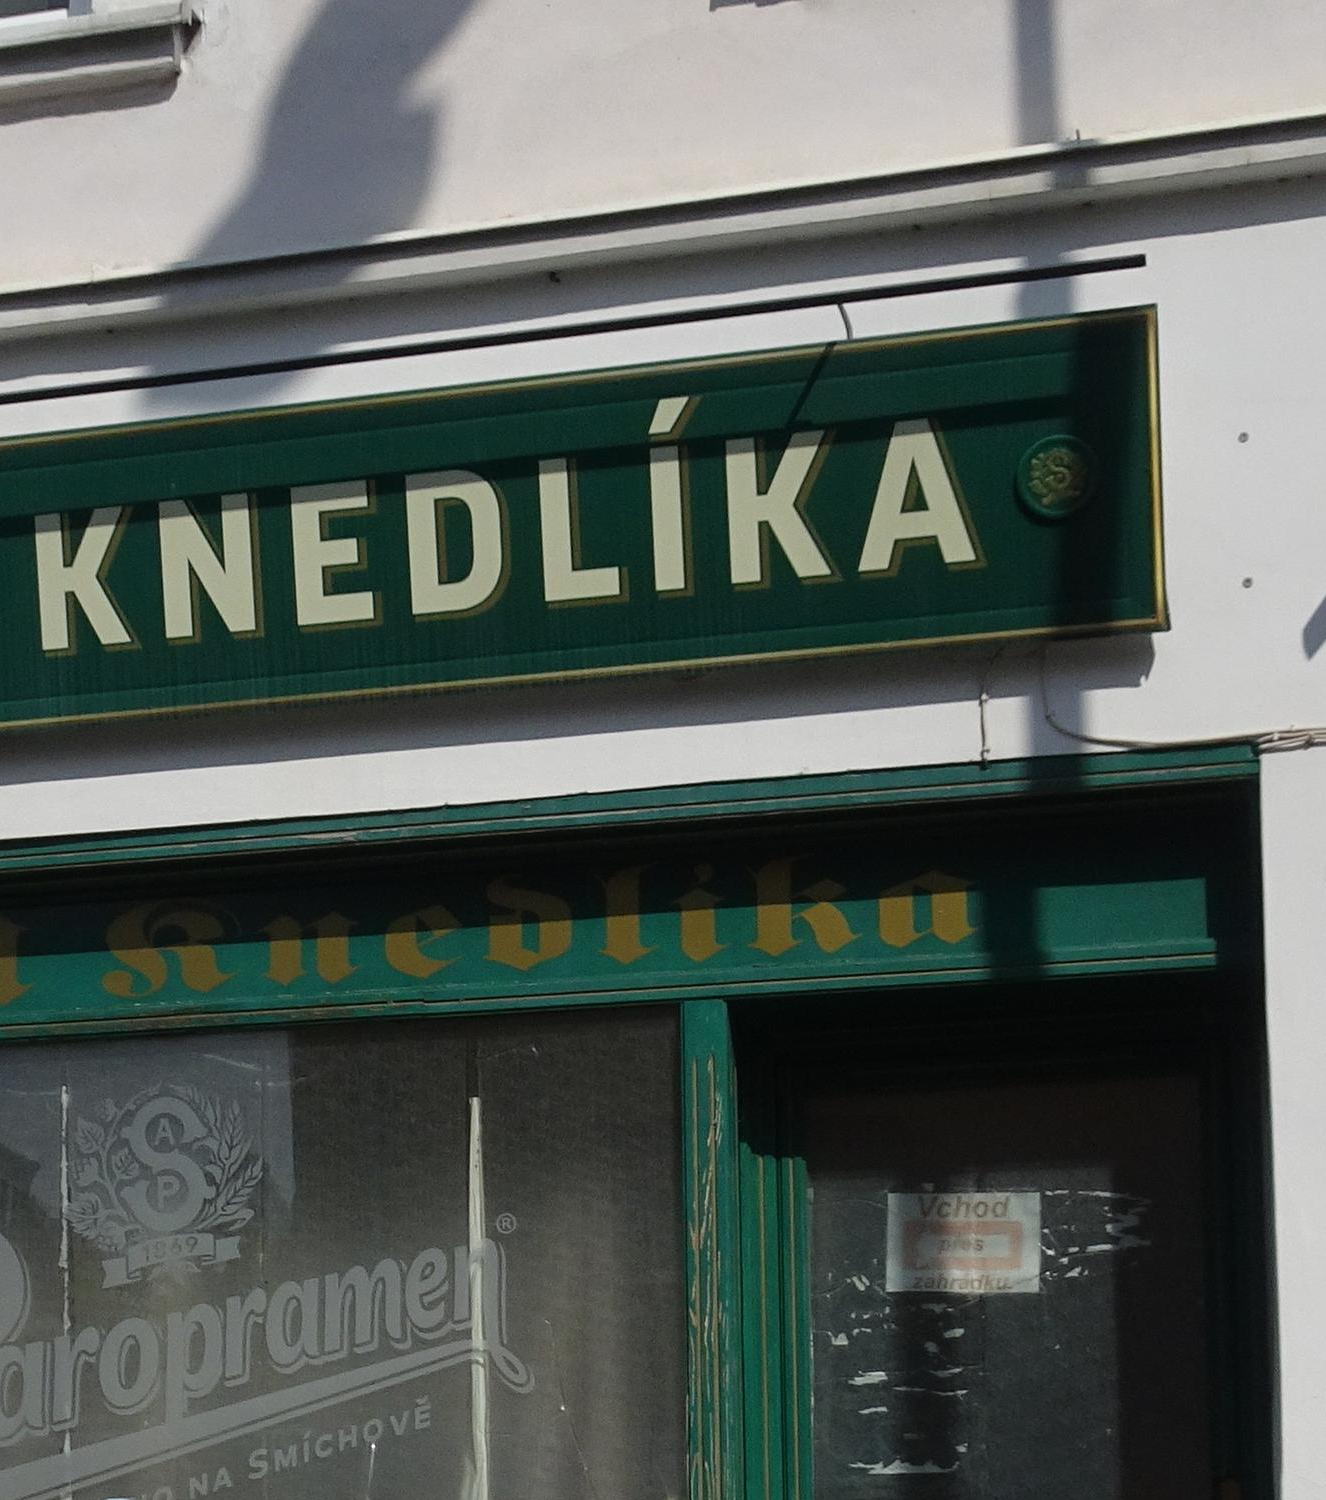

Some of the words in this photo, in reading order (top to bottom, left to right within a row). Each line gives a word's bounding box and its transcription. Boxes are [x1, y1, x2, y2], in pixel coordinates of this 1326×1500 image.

[35, 395, 985, 654] KNEDLÍKA
[101, 856, 978, 997] Knedlika
[919, 1195, 1010, 1219] Vchod
[188, 1466, 234, 1500] NA
[247, 1394, 432, 1481] SMÍCHOVĚ
